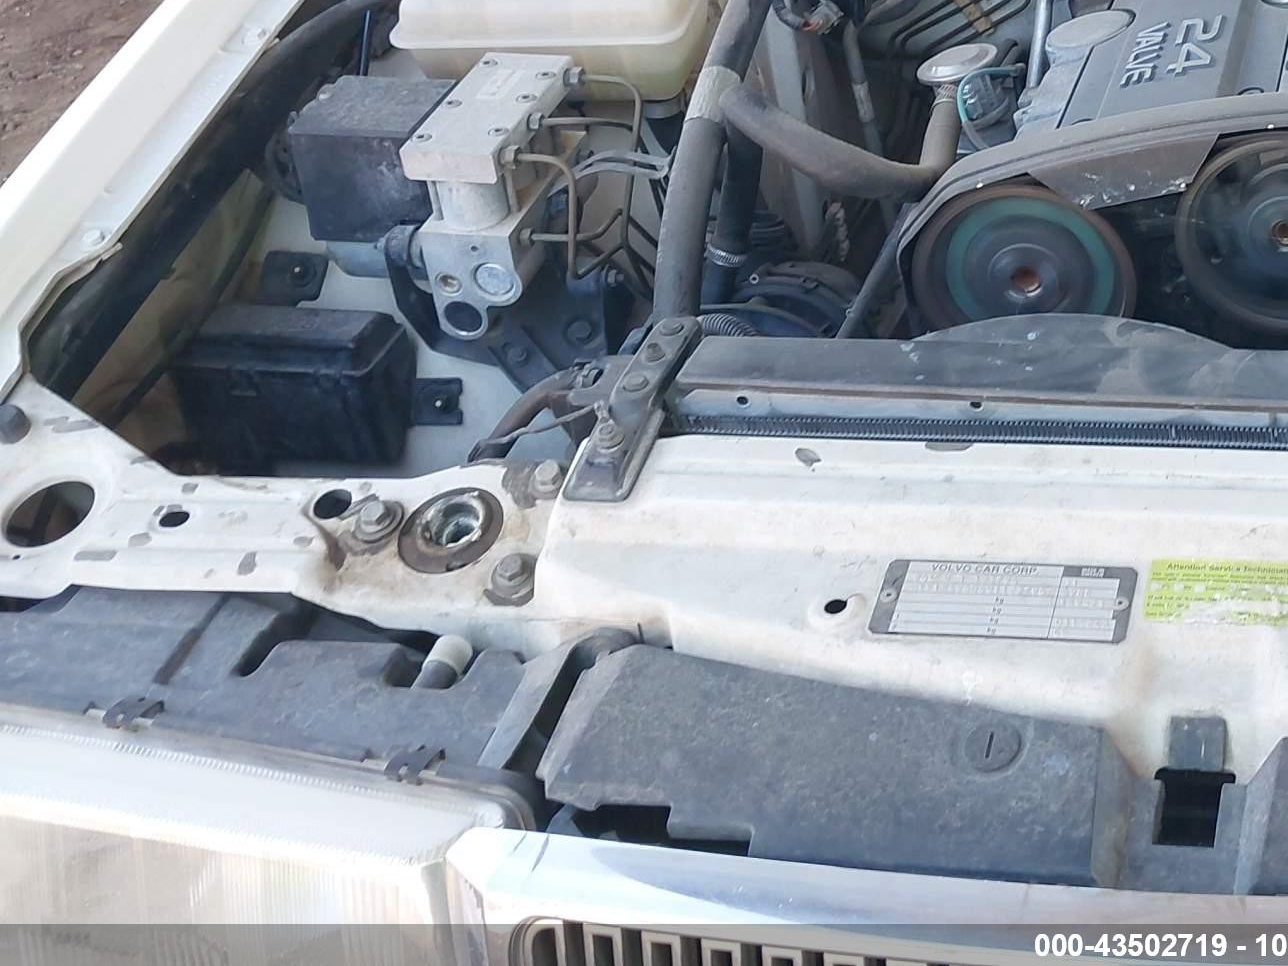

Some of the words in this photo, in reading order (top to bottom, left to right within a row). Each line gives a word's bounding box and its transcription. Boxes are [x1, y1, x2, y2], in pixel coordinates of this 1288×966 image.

[1119, 20, 1171, 90] VALVE
[1165, 14, 1226, 77] 24
[931, 562, 972, 572] VOLVO
[975, 564, 1000, 574] CAR
[1209, 564, 1241, 573] Servie
